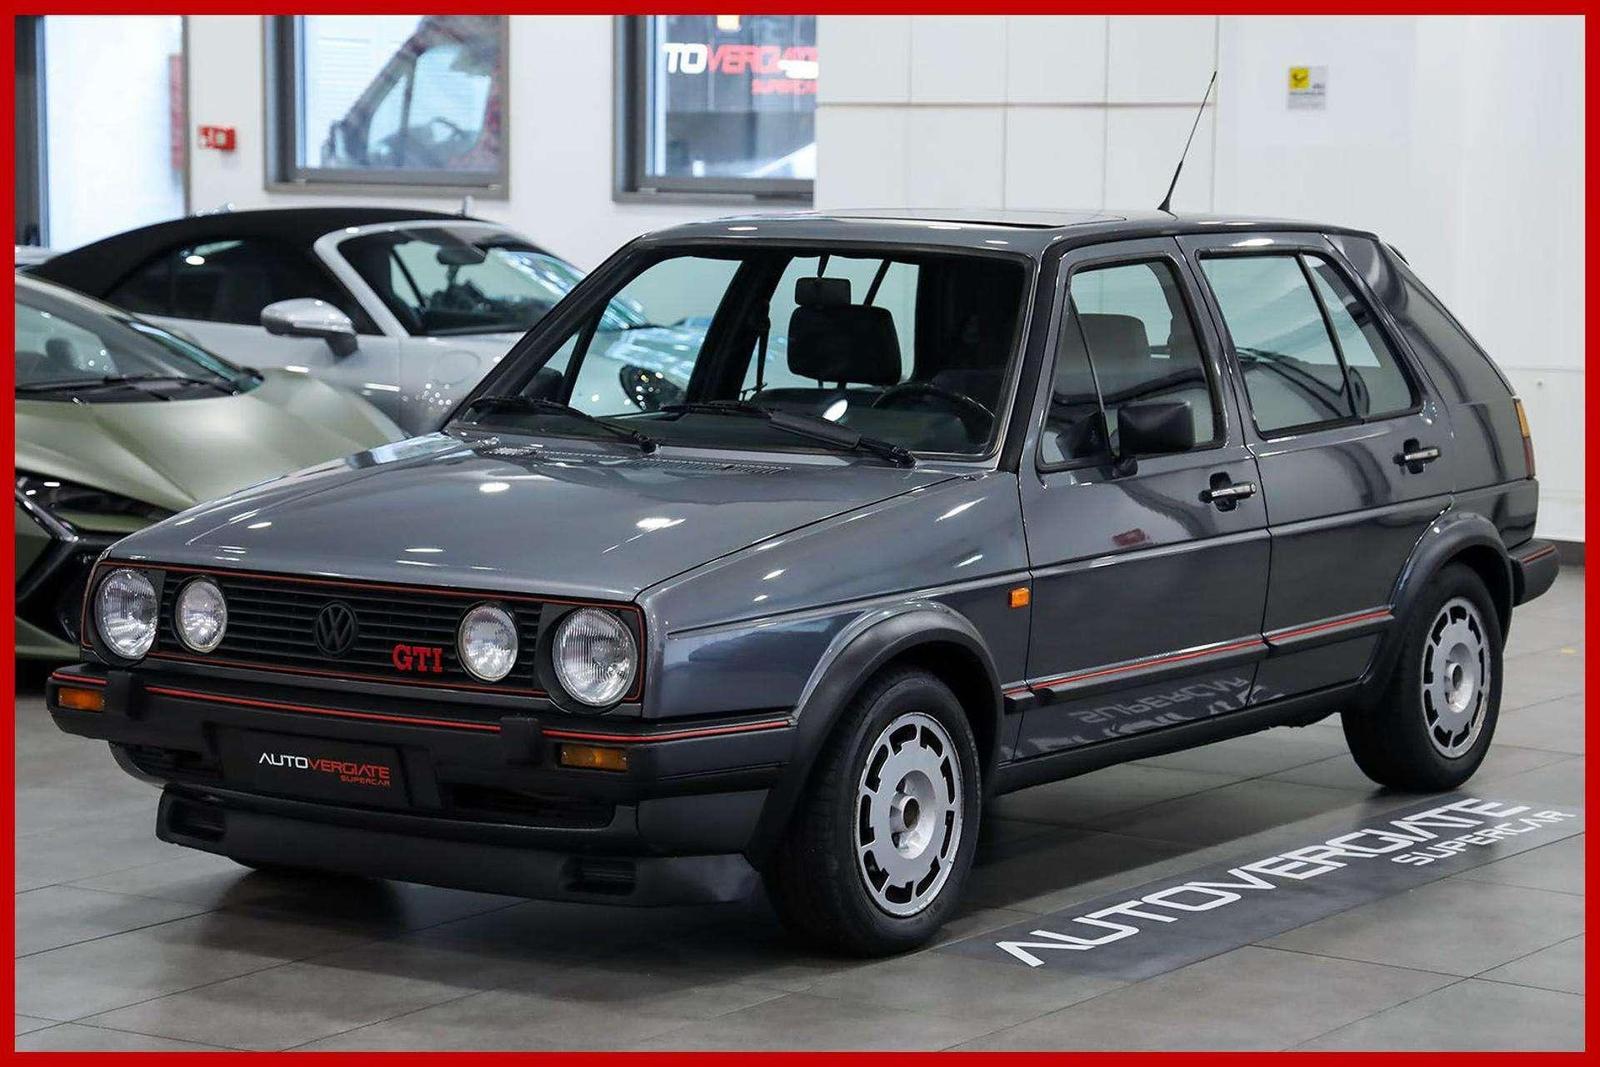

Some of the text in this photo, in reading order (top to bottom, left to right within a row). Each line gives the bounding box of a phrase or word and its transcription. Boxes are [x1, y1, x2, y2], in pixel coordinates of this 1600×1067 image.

[391, 643, 444, 674] GTI
[258, 752, 391, 779] AUTOVERGIATE
[339, 774, 391, 788] SUPERCAR
[1390, 809, 1577, 867] SUPERCAR
[995, 797, 1530, 968] AUTOVERGIATE
